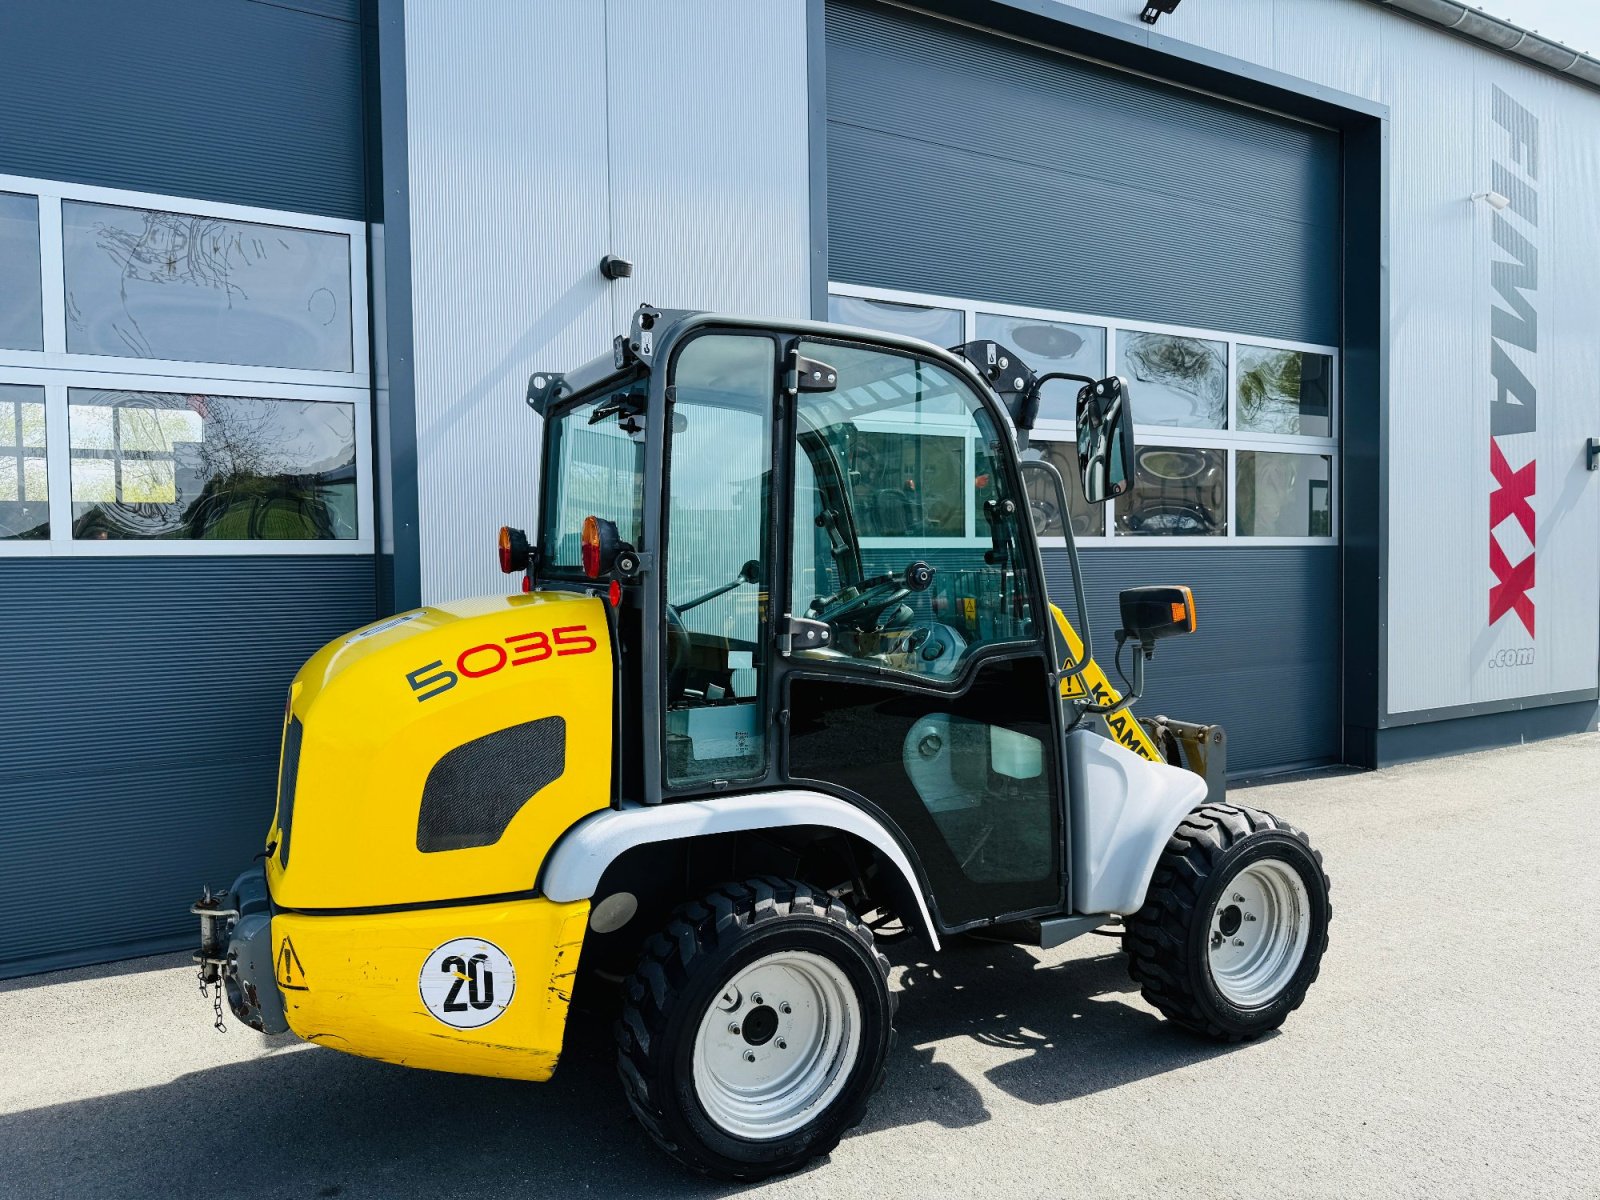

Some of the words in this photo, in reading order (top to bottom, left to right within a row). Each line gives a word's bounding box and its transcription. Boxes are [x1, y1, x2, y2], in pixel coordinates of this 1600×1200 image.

[1489, 83, 1538, 640] FIMAXX
[405, 625, 597, 703] 5035
[1488, 647, 1535, 668] .com
[441, 953, 494, 1012] 20
